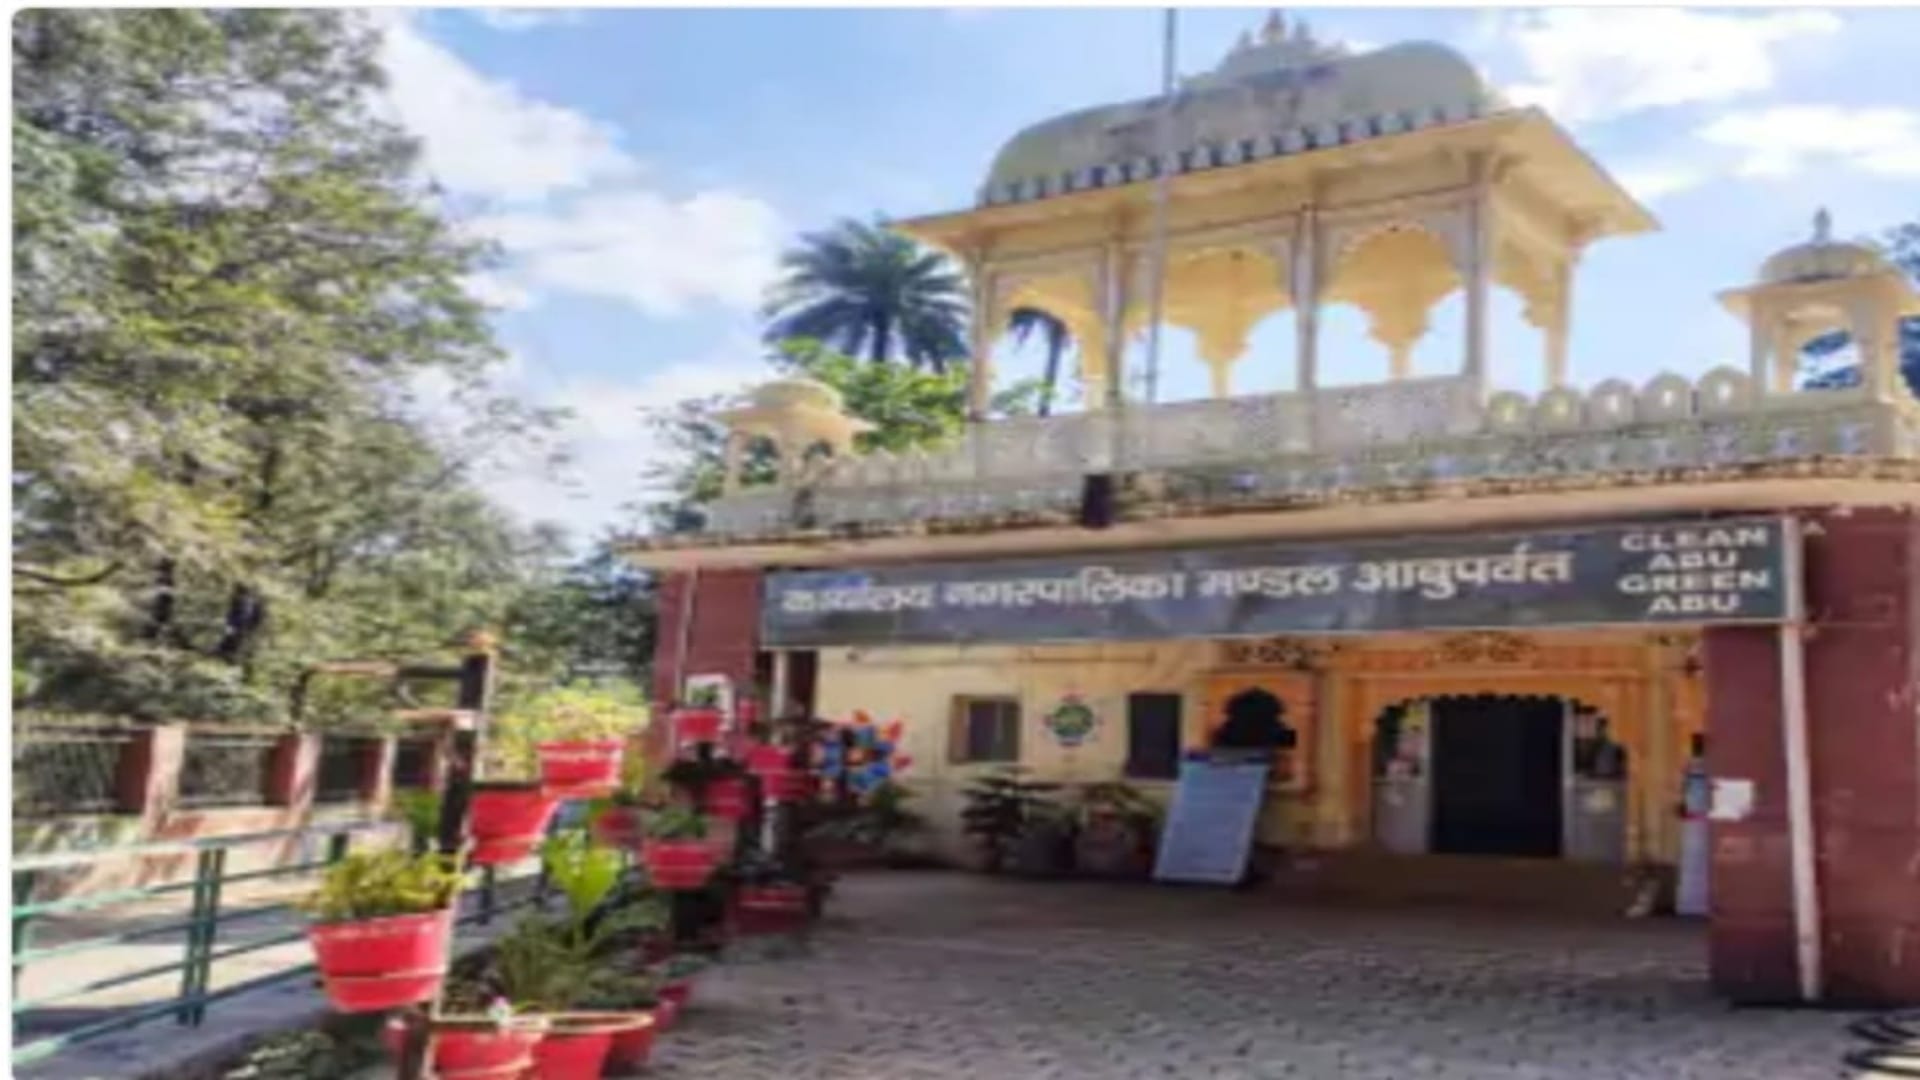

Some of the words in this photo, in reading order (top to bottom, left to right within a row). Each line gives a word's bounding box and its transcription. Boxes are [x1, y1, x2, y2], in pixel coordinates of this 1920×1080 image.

[1620, 526, 1767, 551] CLEAN
[1649, 551, 1738, 570] ABU
[943, 565, 1187, 608] नगरपालिका
[1199, 564, 1341, 597] मण्डल
[1616, 569, 1771, 594] GREEN
[1650, 594, 1740, 614] ABU
